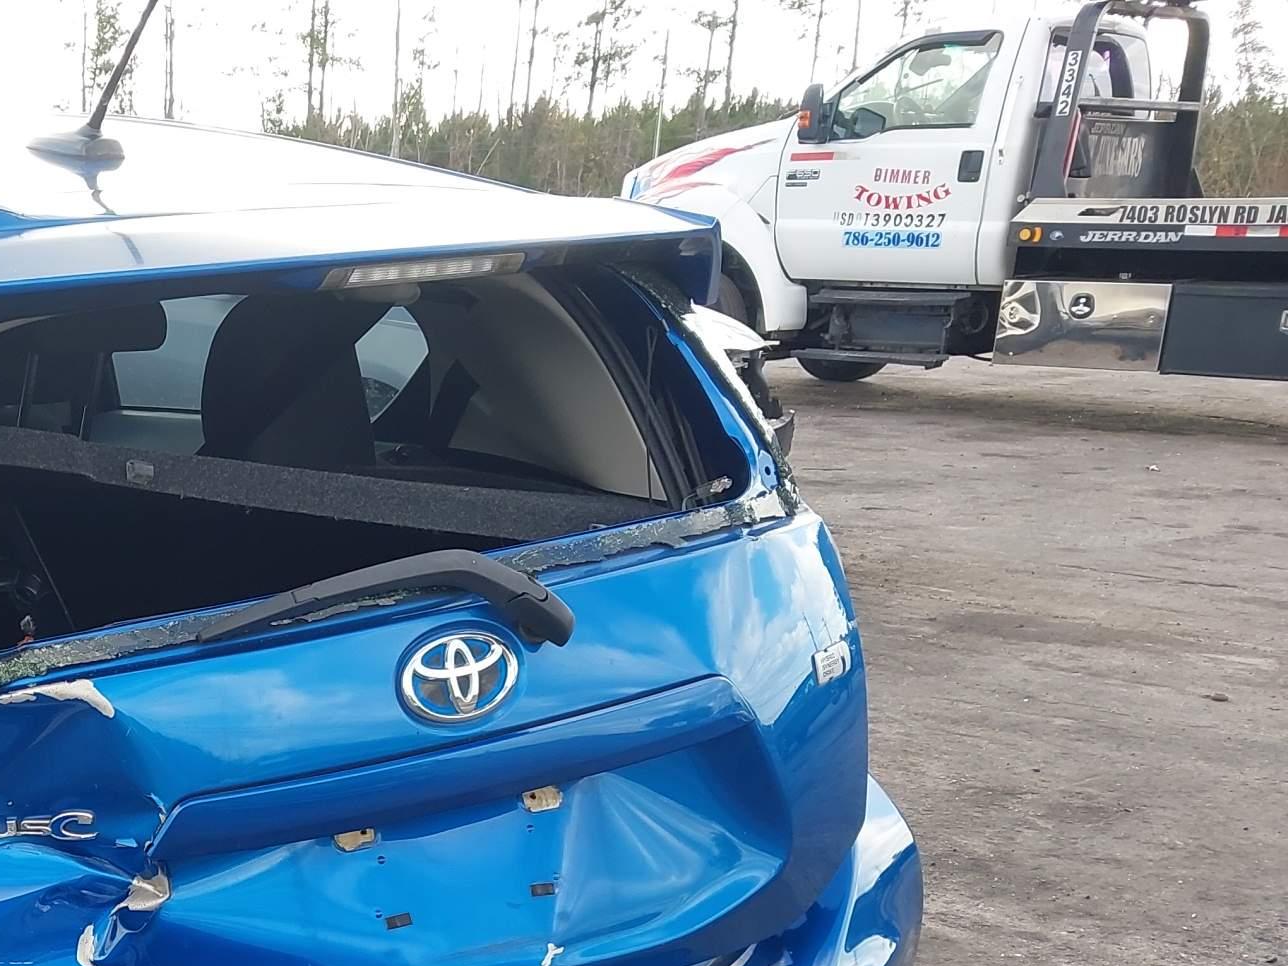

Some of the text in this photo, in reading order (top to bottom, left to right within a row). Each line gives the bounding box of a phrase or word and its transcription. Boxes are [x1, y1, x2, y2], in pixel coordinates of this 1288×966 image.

[1058, 51, 1079, 115] 3342
[854, 183, 952, 210] TOWING
[1119, 205, 1160, 223] 7403
[1164, 203, 1230, 224] ROSLYN
[1233, 205, 1259, 224] RD
[844, 231, 941, 248] 786-250-9612
